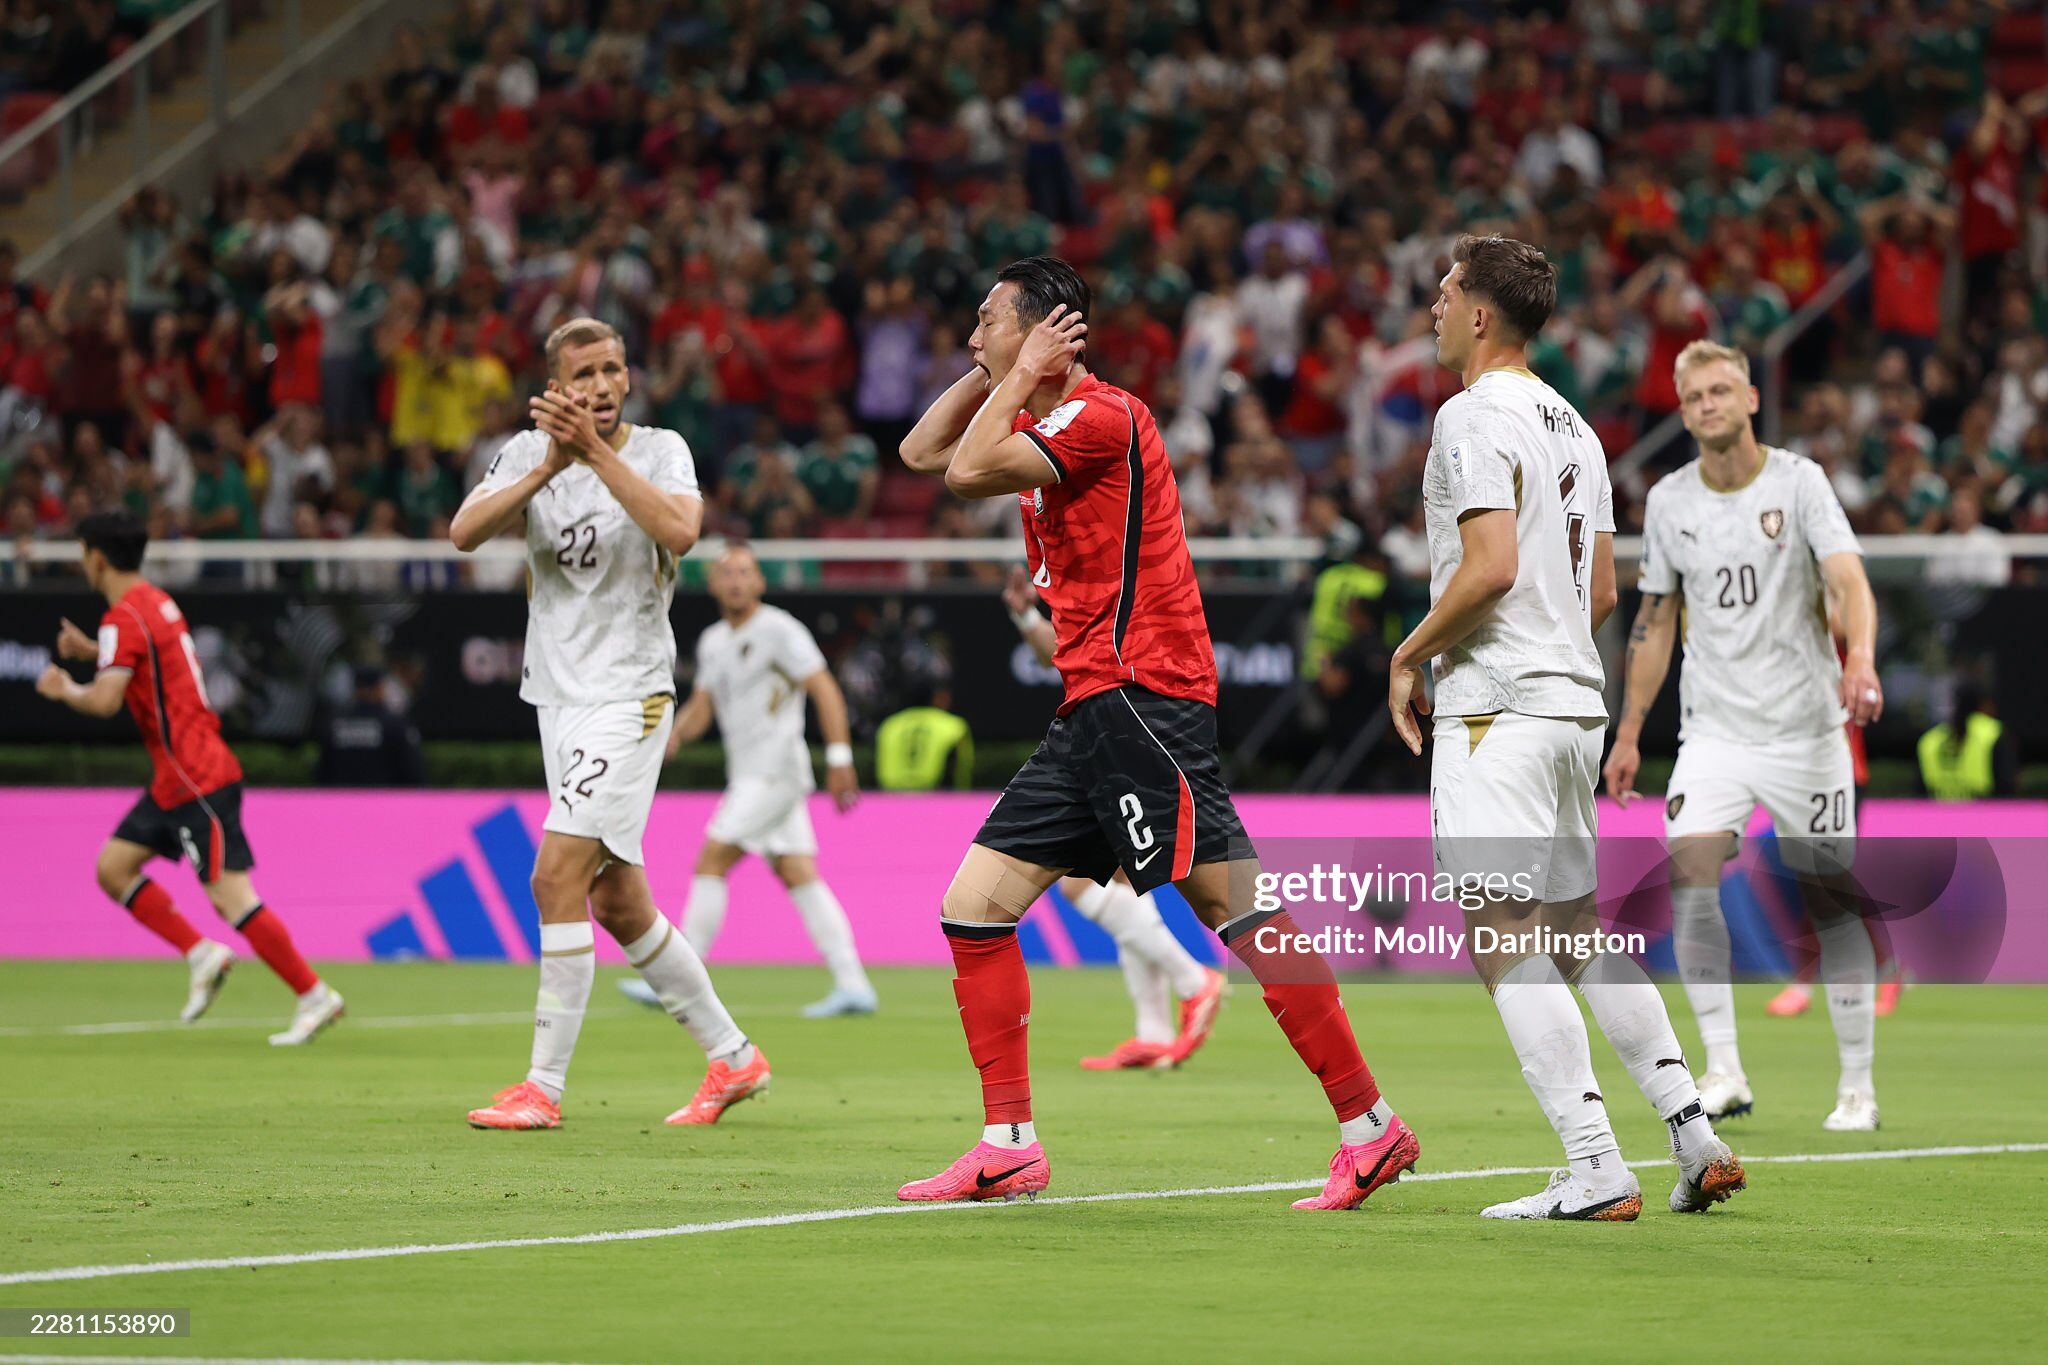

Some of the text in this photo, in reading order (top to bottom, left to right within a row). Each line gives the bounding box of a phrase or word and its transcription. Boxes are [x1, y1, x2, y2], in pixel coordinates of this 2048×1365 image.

[557, 525, 598, 568] 22
[1716, 564, 1758, 609] 20
[561, 748, 609, 798] 22
[1118, 792, 1155, 851] 2
[1809, 789, 1847, 833] 20
